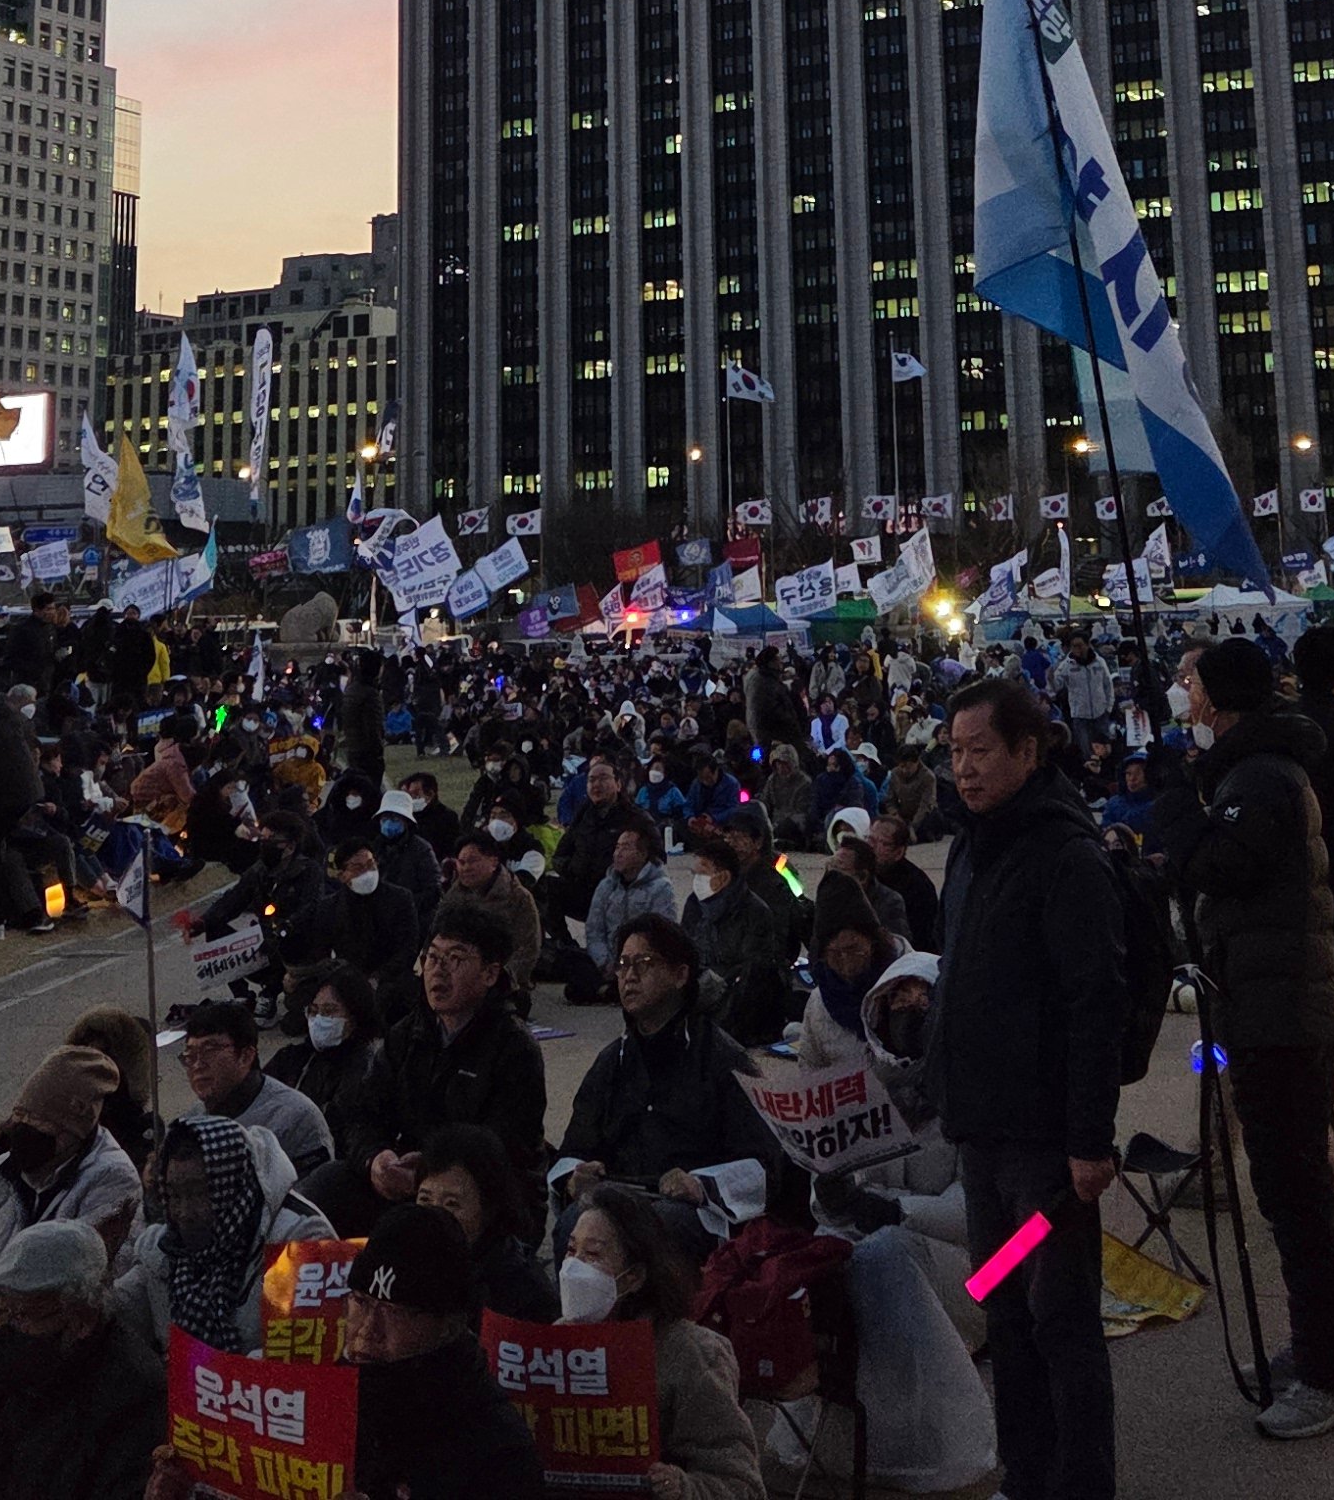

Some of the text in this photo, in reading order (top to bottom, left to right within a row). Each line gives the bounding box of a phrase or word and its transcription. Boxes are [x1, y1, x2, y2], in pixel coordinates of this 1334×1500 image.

[752, 1071, 867, 1123] 내란세력
[267, 1317, 327, 1365] 즉각
[498, 1340, 609, 1396] 윤석열
[194, 1364, 306, 1445] 윤석열
[550, 1404, 651, 1457] 파면!
[172, 1413, 243, 1486] 즉각
